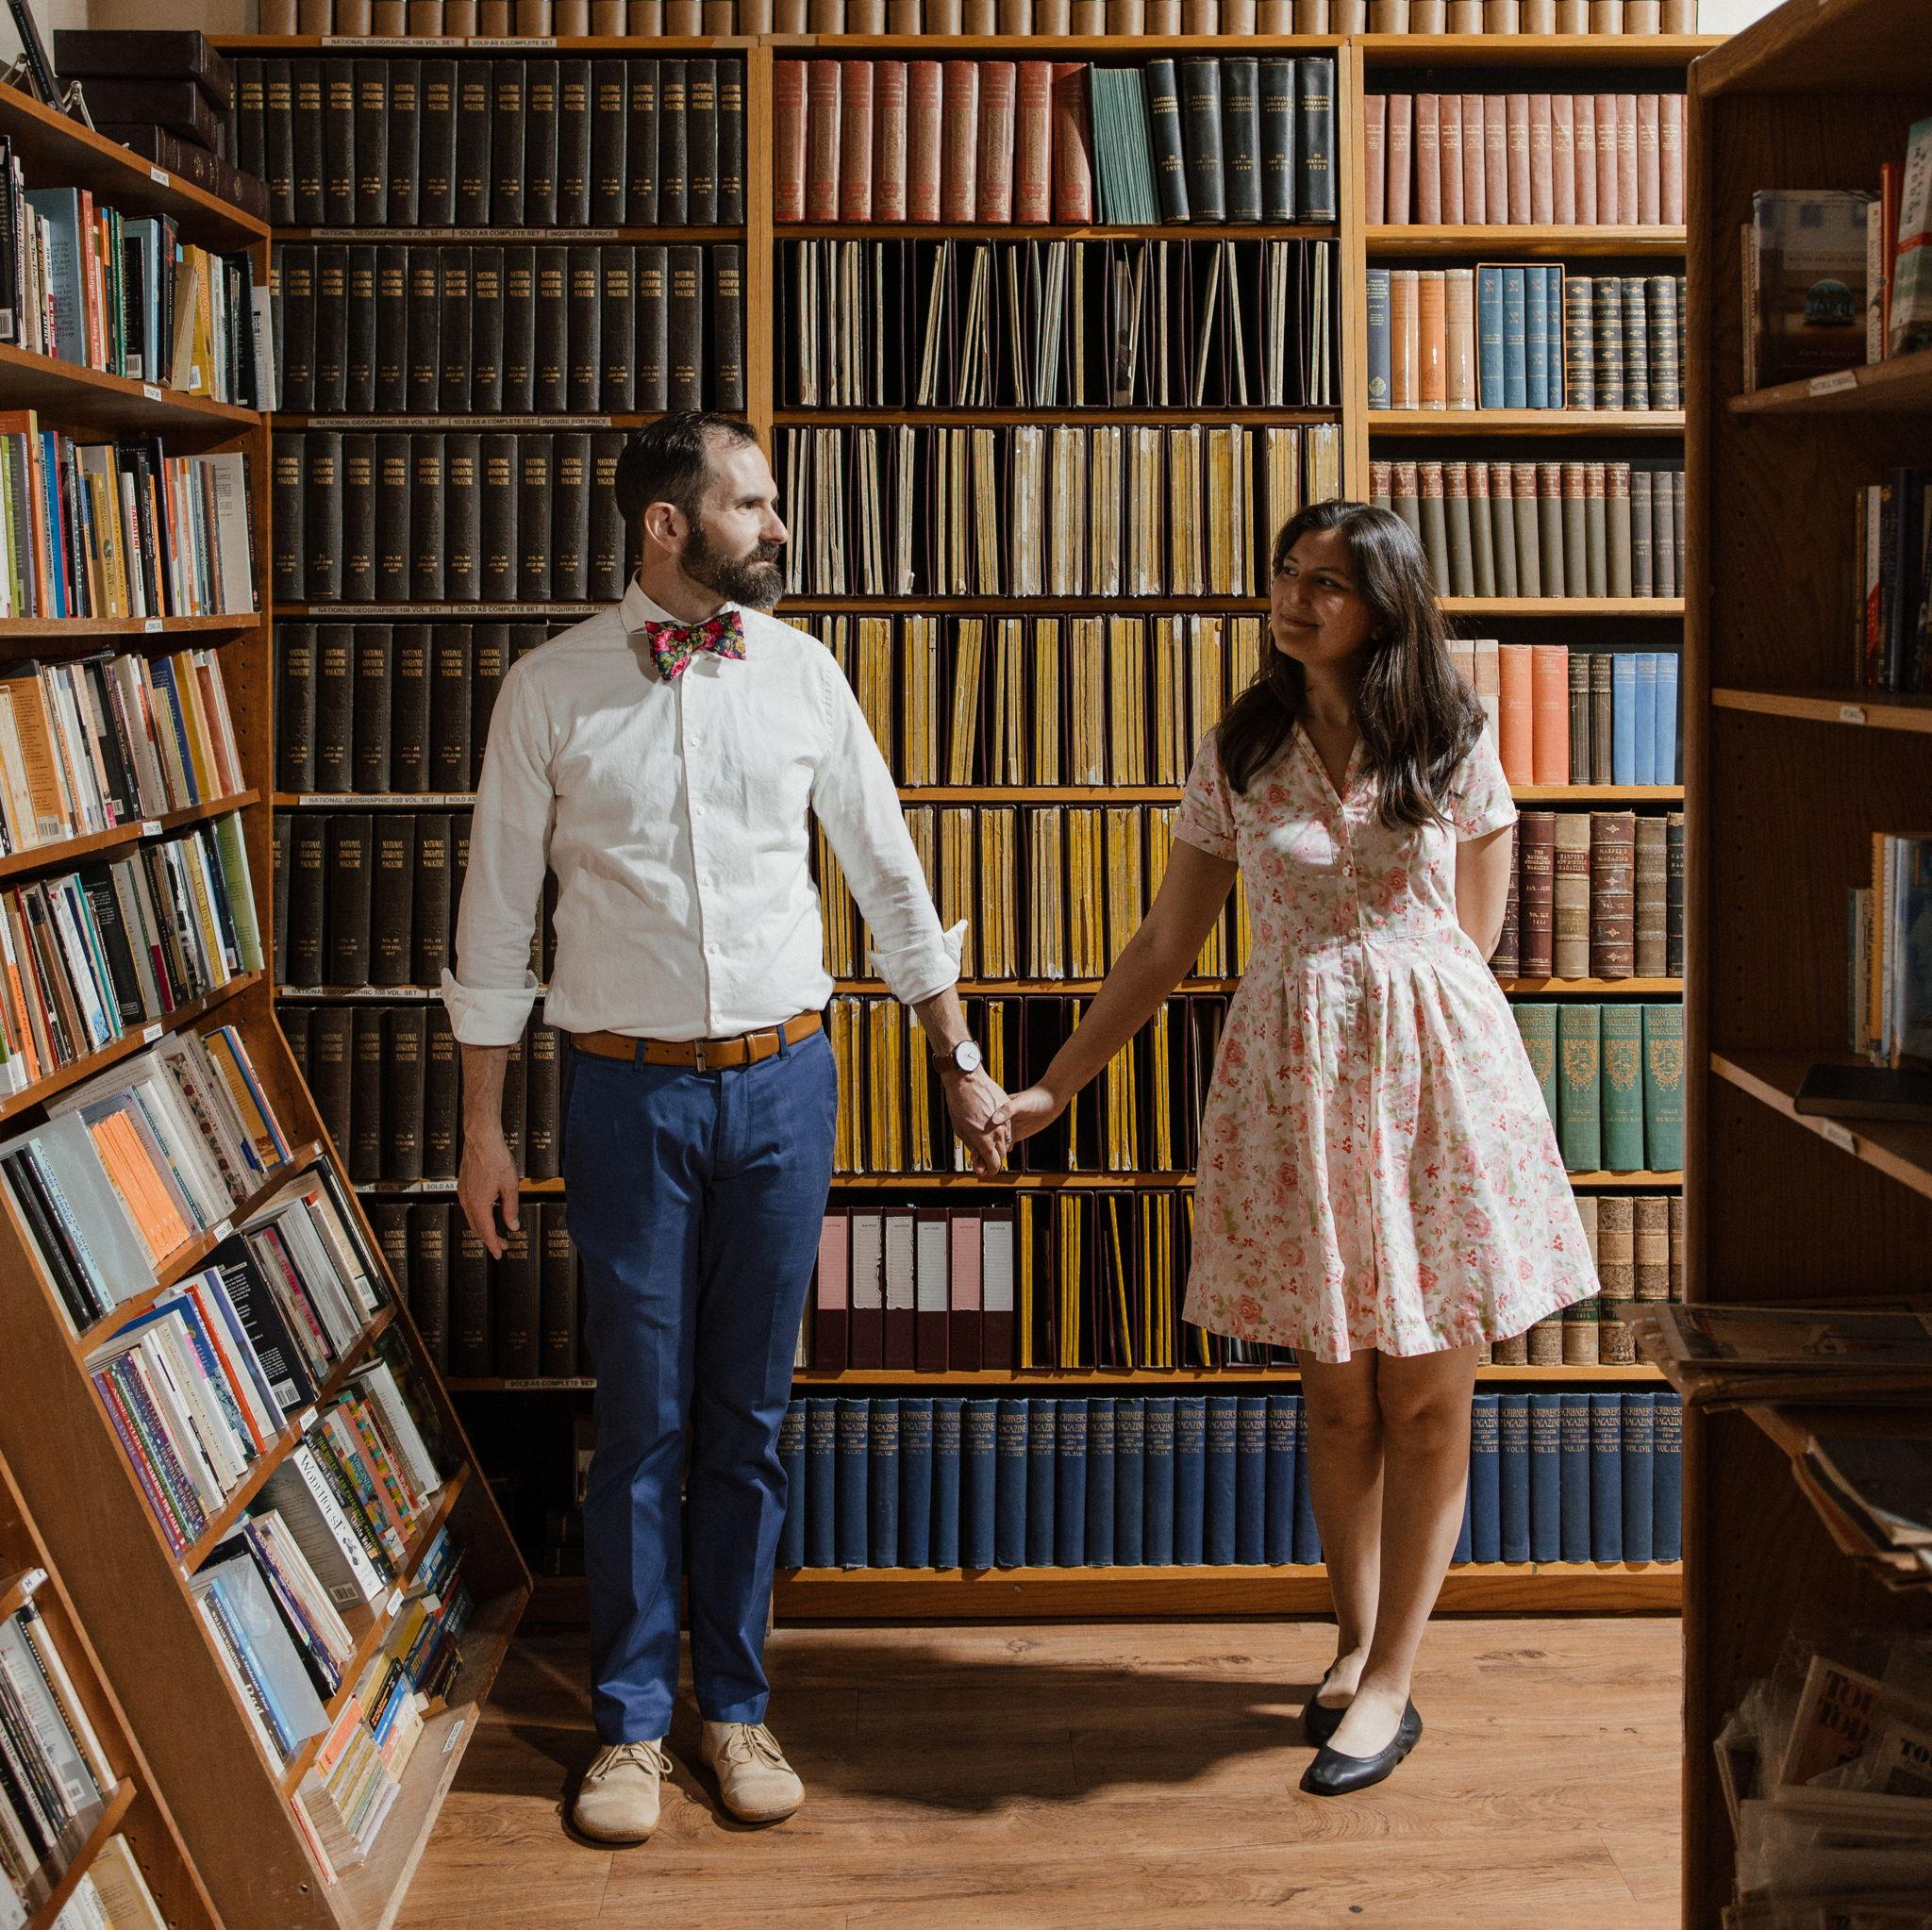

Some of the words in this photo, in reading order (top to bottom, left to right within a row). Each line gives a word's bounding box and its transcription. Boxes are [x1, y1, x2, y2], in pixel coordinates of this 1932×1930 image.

[87, 226, 95, 254] Shadow
[49, 301, 54, 312] WE
[89, 270, 97, 300] Banyan
[130, 504, 141, 551] SABATINI
[135, 552, 144, 592] Scaramouche
[42, 1153, 75, 1219] CONFEDERACY
[79, 1234, 99, 1272] DUNCES
[132, 1368, 150, 1398] ANNE
[144, 1398, 165, 1432] TYLER
[510, 1379, 528, 1388] SOLD
[530, 1379, 541, 1388] AS
[541, 1379, 577, 1388] COMPLETE
[579, 1379, 594, 1388] SET
[111, 1386, 128, 1414] ANNE
[125, 1417, 145, 1452] TYLER
[305, 1433, 318, 1450] What
[312, 1448, 330, 1473] Remains
[327, 1476, 338, 1490] Other
[335, 1489, 346, 1506] Stories
[317, 1436, 328, 1452] TOM
[324, 1450, 339, 1472] WOLFE
[352, 1453, 375, 1491] VIRGINIA
[145, 1460, 166, 1498] SEARCHING
[162, 1498, 173, 1514] FOR
[169, 1512, 183, 1536] CALEB
[164, 1441, 176, 1459] THE
[182, 1484, 202, 1517] WINDER
[301, 1454, 347, 1538] WODEHOUSE
[339, 1477, 349, 1491] AM
[349, 1515, 366, 1538] Christa
[360, 1536, 373, 1552] Wolf
[211, 1610, 227, 1639] WILLIAM
[224, 1639, 242, 1671] WHARTON
[213, 1596, 230, 1623] WILLIAM
[243, 1659, 262, 1691] Midnight
[258, 1690, 272, 1712] Clear
[245, 1683, 265, 1715] Dad
